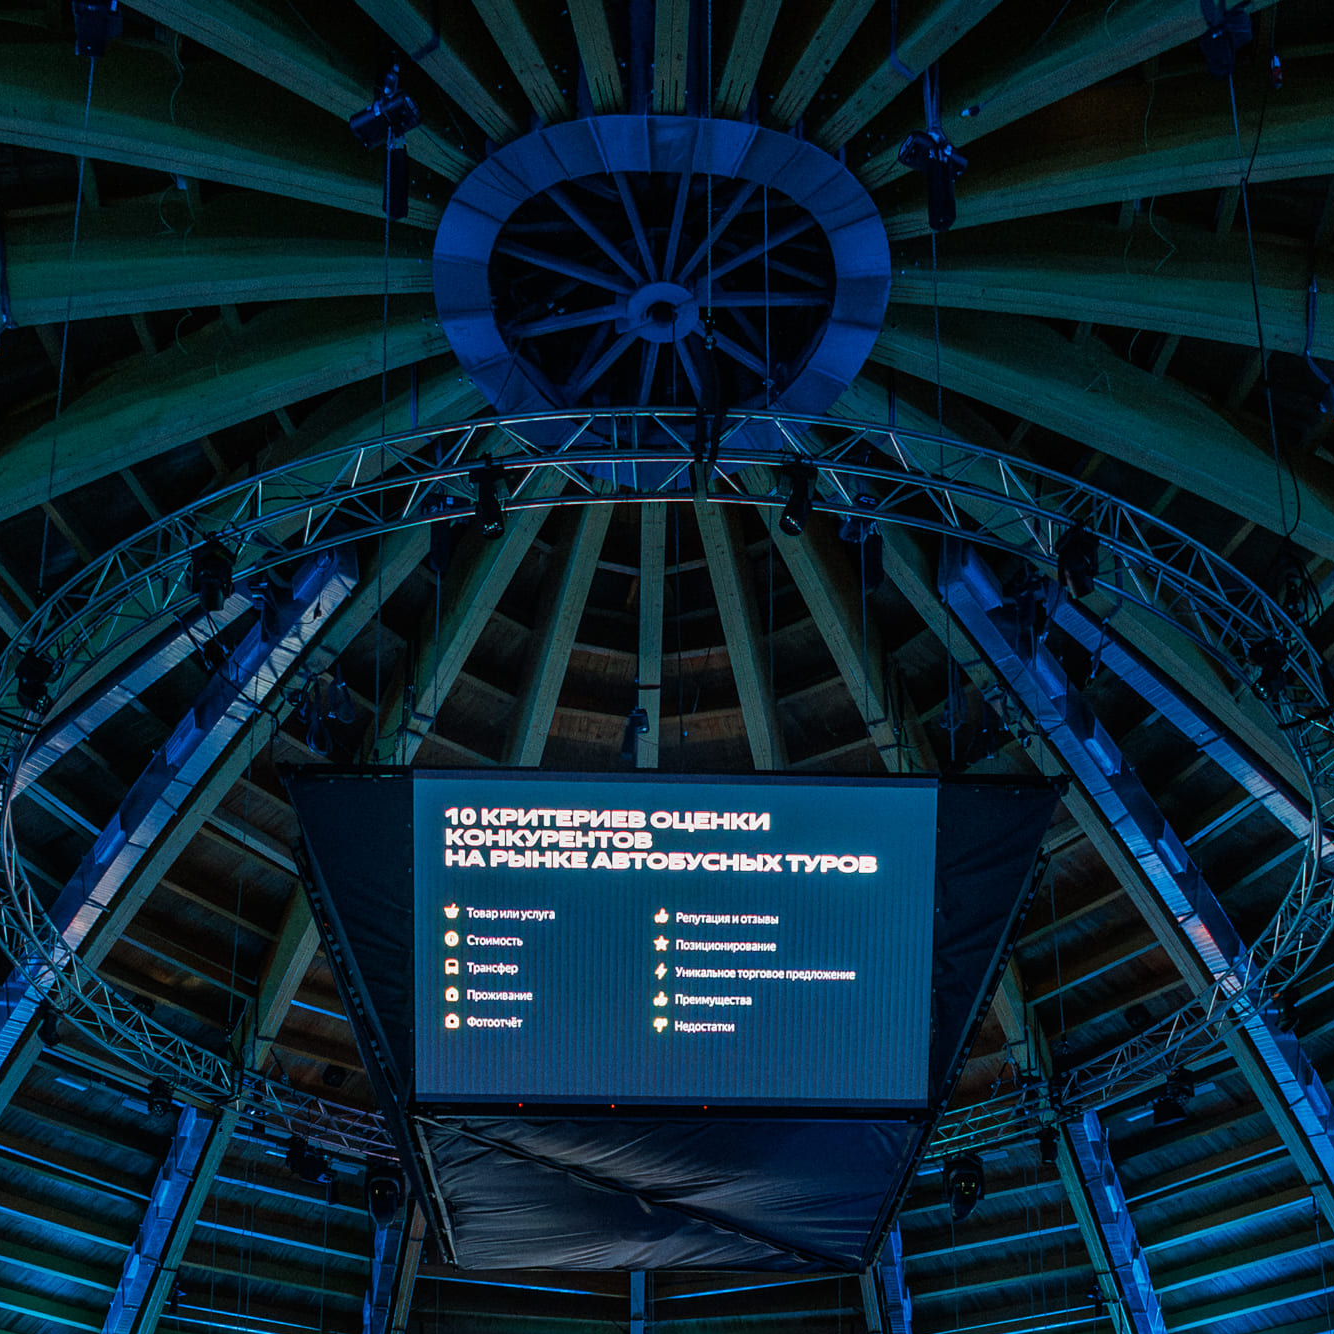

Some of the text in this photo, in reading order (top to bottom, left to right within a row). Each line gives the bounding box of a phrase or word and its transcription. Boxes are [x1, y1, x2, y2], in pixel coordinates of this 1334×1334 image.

[445, 808, 770, 832] 10 КРИТЕРИЕВ ОЦЕНКИ
[445, 829, 652, 849] КОНКУРЕНТОВ
[445, 850, 878, 873] НА РЫНКЕ АВТОБУСНЫХ ТУРОВ
[466, 907, 498, 920] Товар
[520, 910, 555, 921] услуга
[676, 912, 730, 925] Репутация
[740, 915, 779, 924] отзывы
[467, 935, 523, 946] Стоимость
[676, 939, 776, 953] Позиционирование
[467, 962, 518, 975] Трансфер
[675, 967, 856, 981] Уникальное торговое предложение
[467, 989, 532, 1002] Проживание
[675, 994, 752, 1007] Преимущества
[467, 1016, 523, 1028] Фотоотчёт
[675, 1020, 735, 1033] Недостатки
